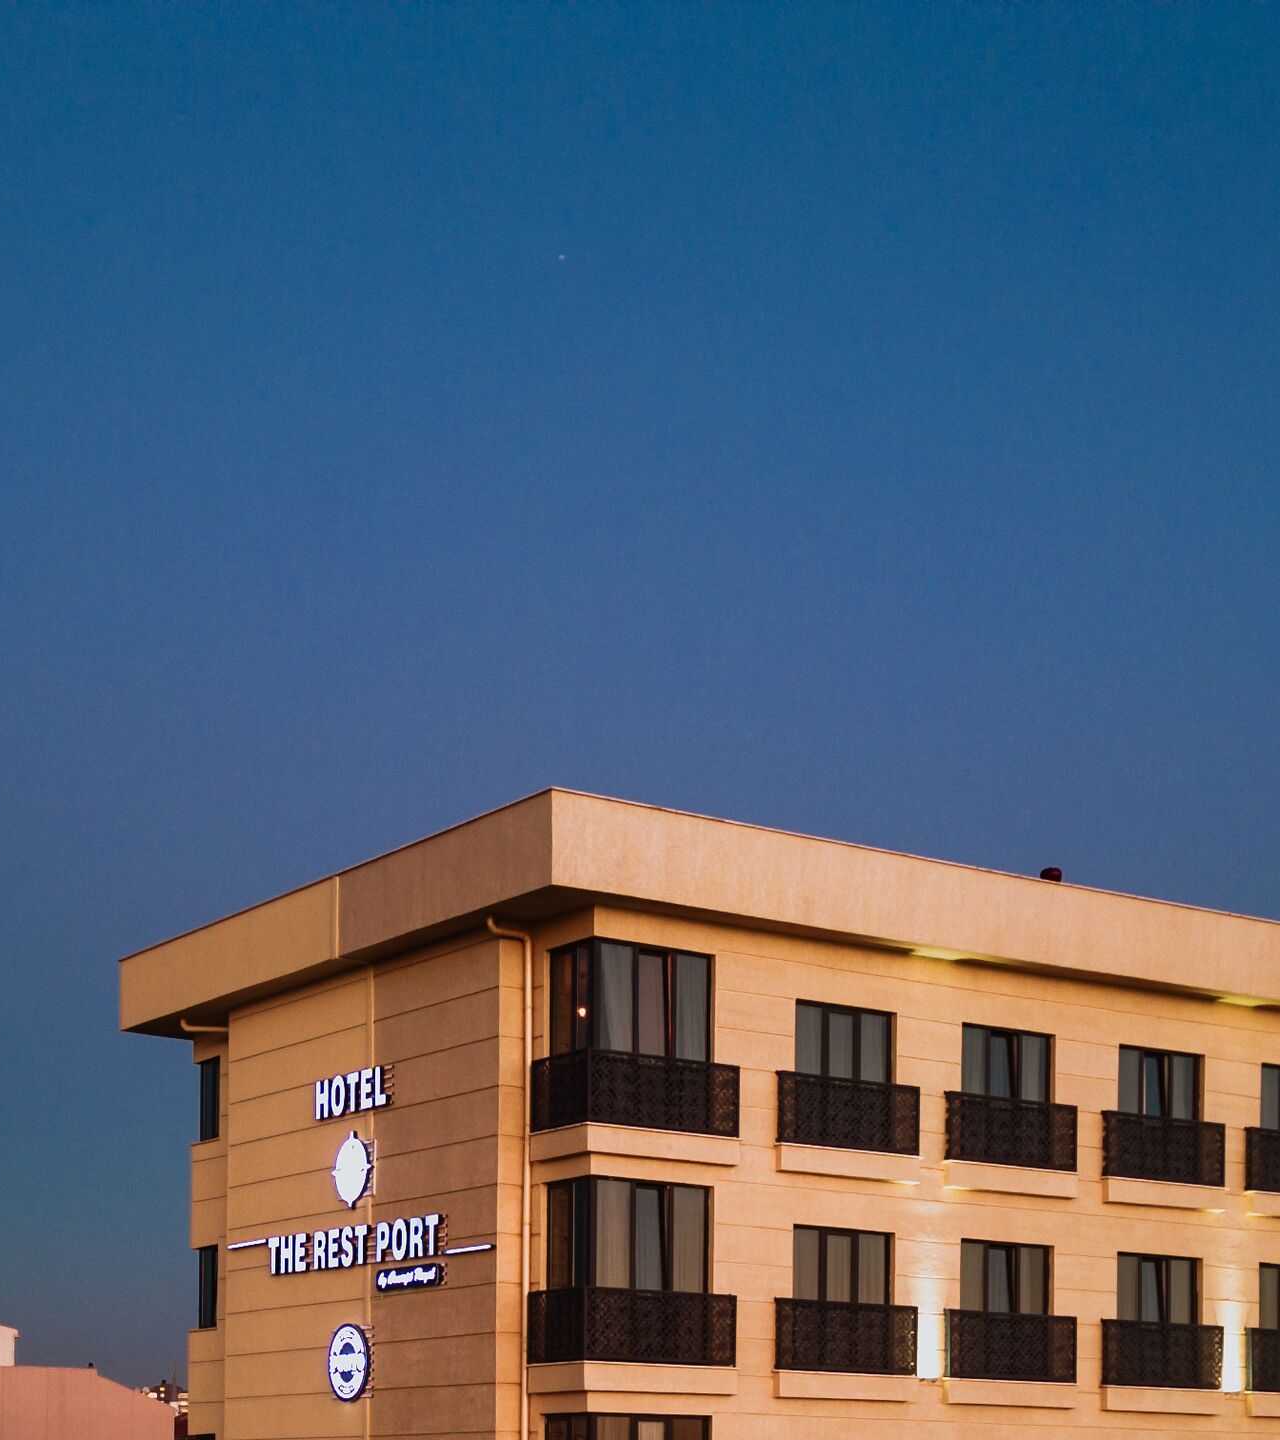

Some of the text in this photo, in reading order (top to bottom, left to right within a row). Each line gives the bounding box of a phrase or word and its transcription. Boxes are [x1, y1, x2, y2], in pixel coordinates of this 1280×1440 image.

[315, 1065, 387, 1121] HOTEL
[267, 1213, 439, 1275] THE REST PORT
